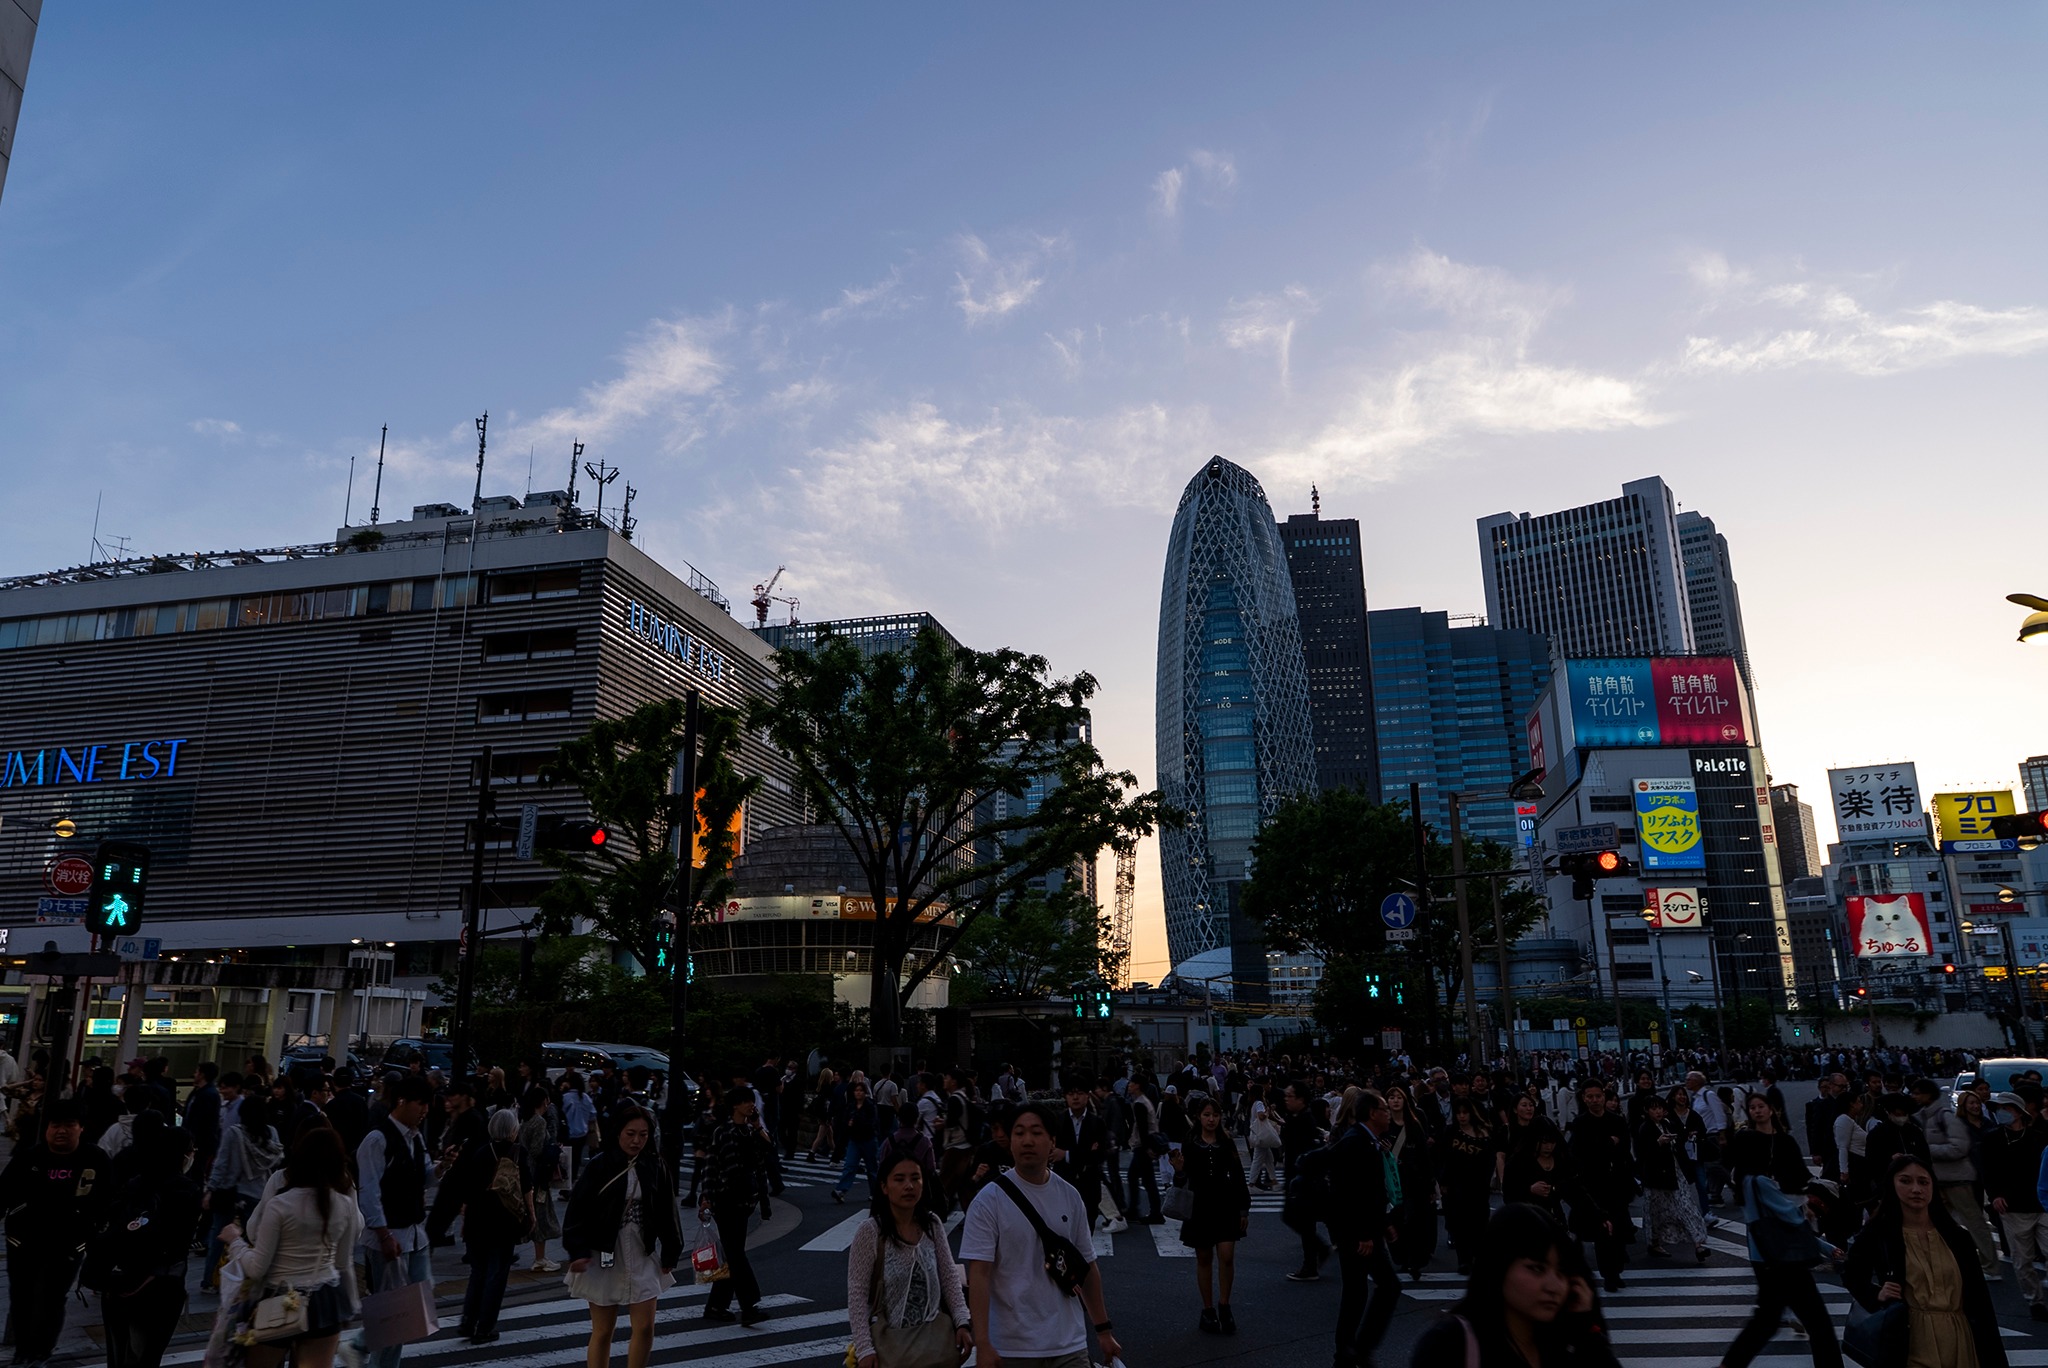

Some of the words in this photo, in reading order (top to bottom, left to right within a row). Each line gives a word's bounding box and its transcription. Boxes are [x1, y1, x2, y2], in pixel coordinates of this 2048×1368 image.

[630, 599, 695, 667] LUMINE
[699, 643, 724, 682] EST
[1588, 675, 1634, 695] 龍角散
[1671, 673, 1718, 695] 龍角散
[1585, 697, 1646, 716] ダイレクト
[1668, 695, 1729, 715] ダイレクト
[119, 738, 188, 780] EST
[1844, 771, 1901, 785] ラクマチ
[1838, 785, 1915, 819] 楽待
[1954, 794, 1997, 815] プロ
[1647, 815, 1693, 828] リブふわ
[520, 806, 534, 859] スクランブル式
[1558, 826, 1613, 841] 新宿駅東口
[1648, 829, 1694, 845] マスク
[1558, 840, 1590, 850] Shinjuku
[1964, 842, 1993, 850] プロミス
[55, 868, 91, 884] 消火栓
[1663, 903, 1697, 912] スシロー
[1700, 897, 1709, 917] 6F
[148, 941, 157, 953] P
[1452, 1138, 1483, 1155] PAST
